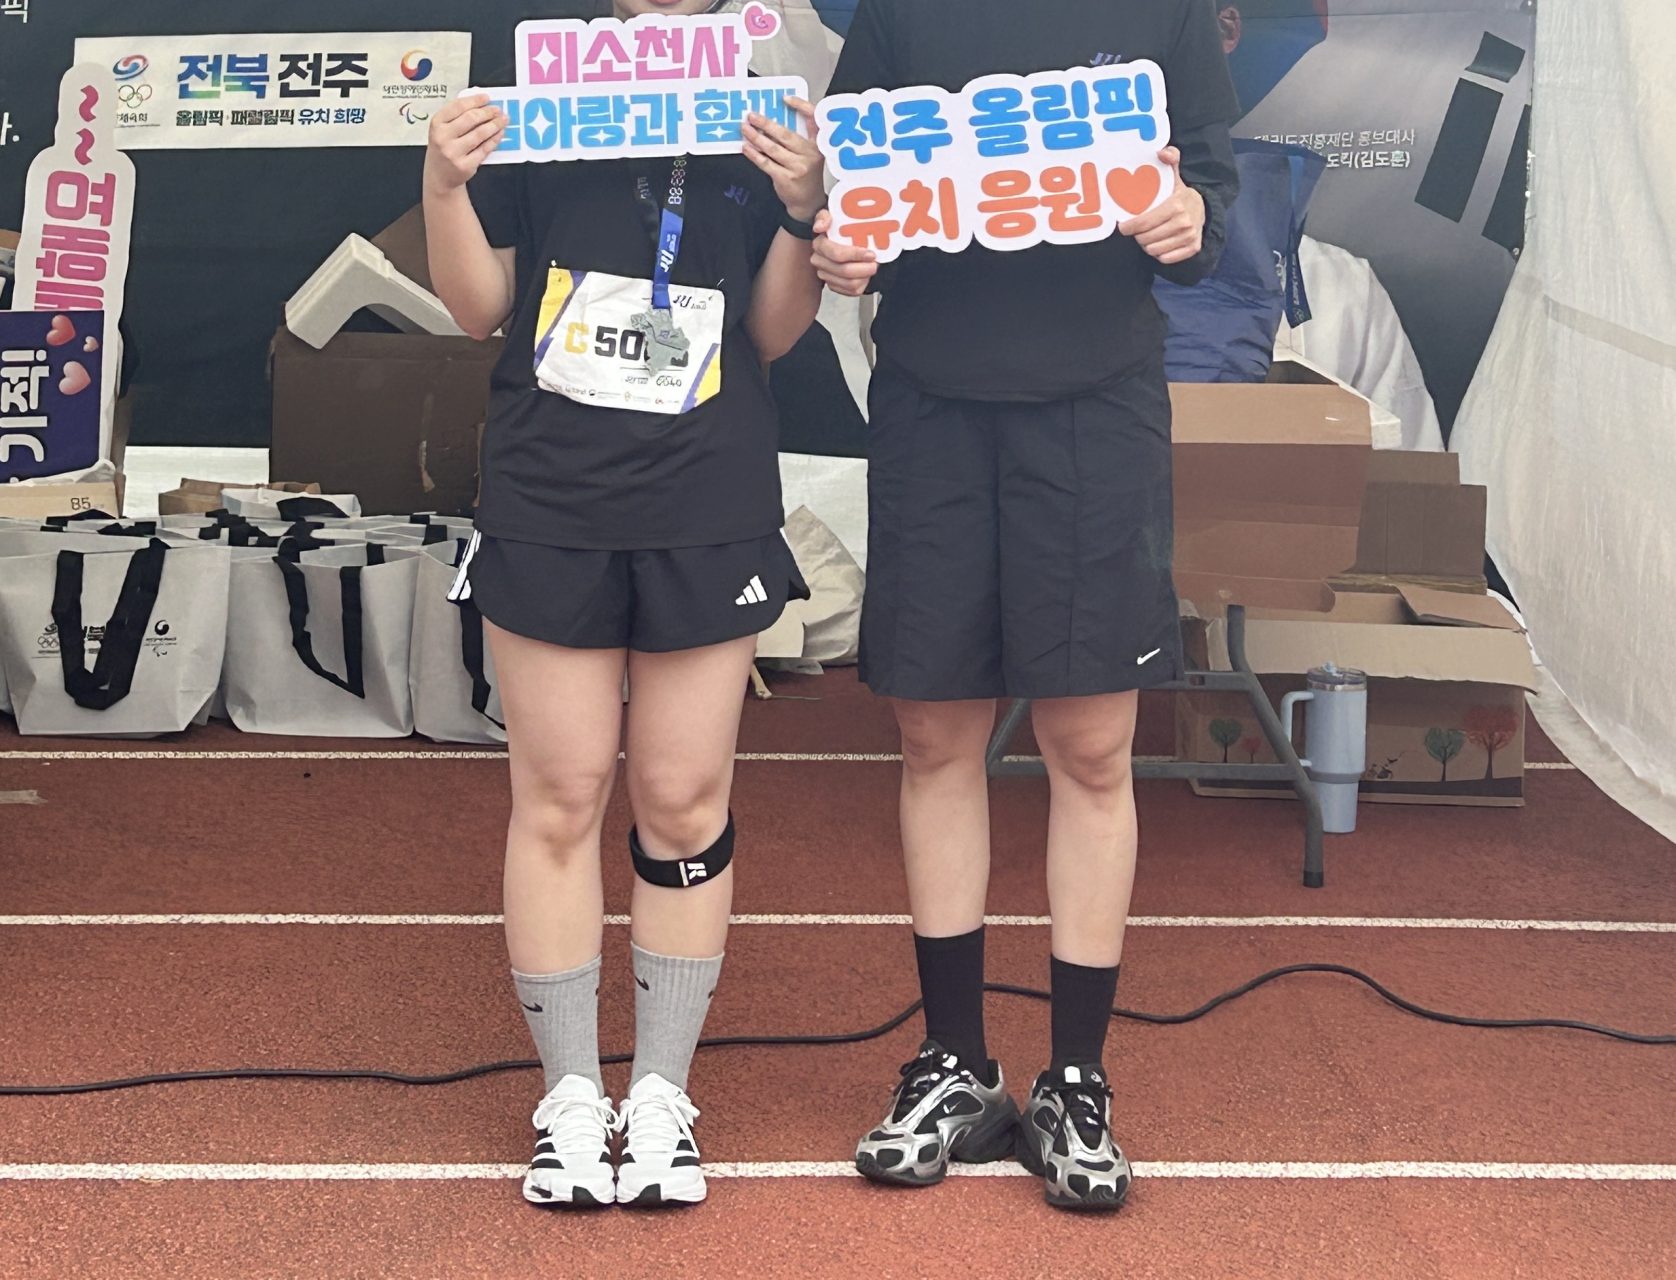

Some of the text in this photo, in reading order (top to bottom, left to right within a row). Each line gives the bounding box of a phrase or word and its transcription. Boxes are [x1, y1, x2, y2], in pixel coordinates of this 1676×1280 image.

[177, 53, 369, 99] 전북 전주
[528, 26, 740, 85] 미소천사
[298, 109, 331, 124] 유치
[333, 108, 366, 124] 희망
[827, 73, 1157, 170] 전주 올림픽
[1359, 128, 1415, 146] 홍보대사
[839, 162, 1103, 250] 유치 응원
[594, 325, 688, 368] 50
